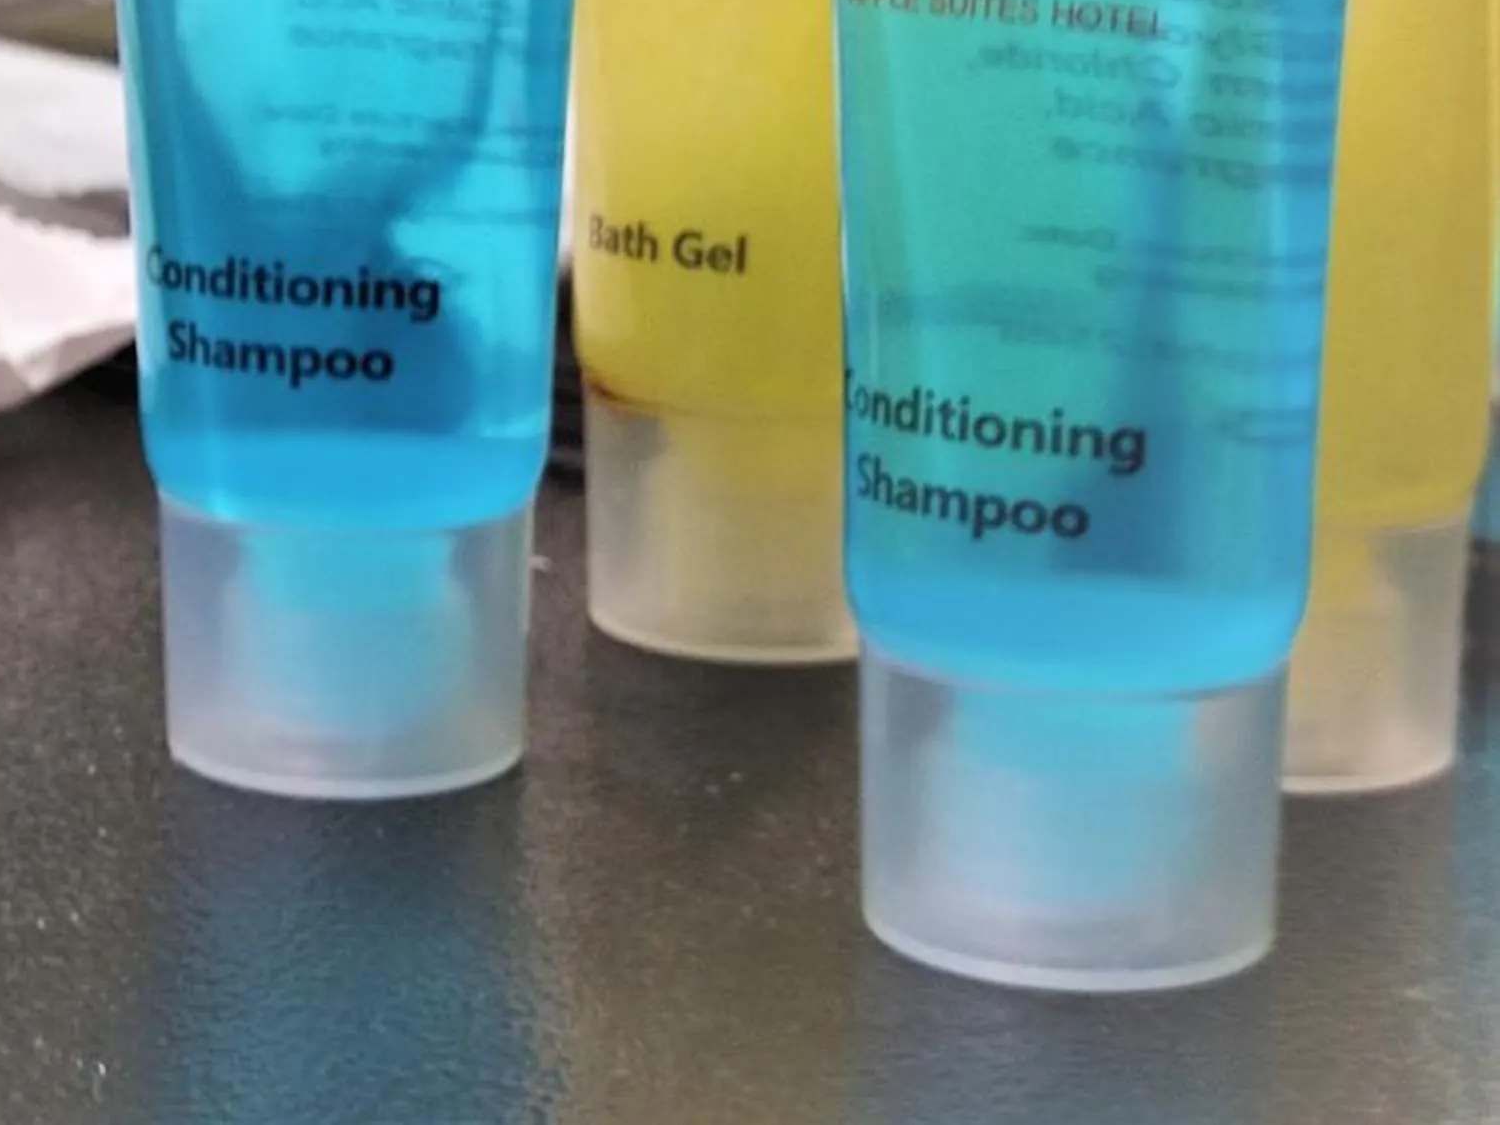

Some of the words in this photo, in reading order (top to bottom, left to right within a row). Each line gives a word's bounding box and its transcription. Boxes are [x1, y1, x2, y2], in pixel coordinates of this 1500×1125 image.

[588, 215, 658, 263] Bath
[672, 227, 748, 276] Gel
[147, 243, 440, 323] Conditioning
[168, 320, 393, 387] Shampoo
[856, 451, 1091, 539] Shampoo
